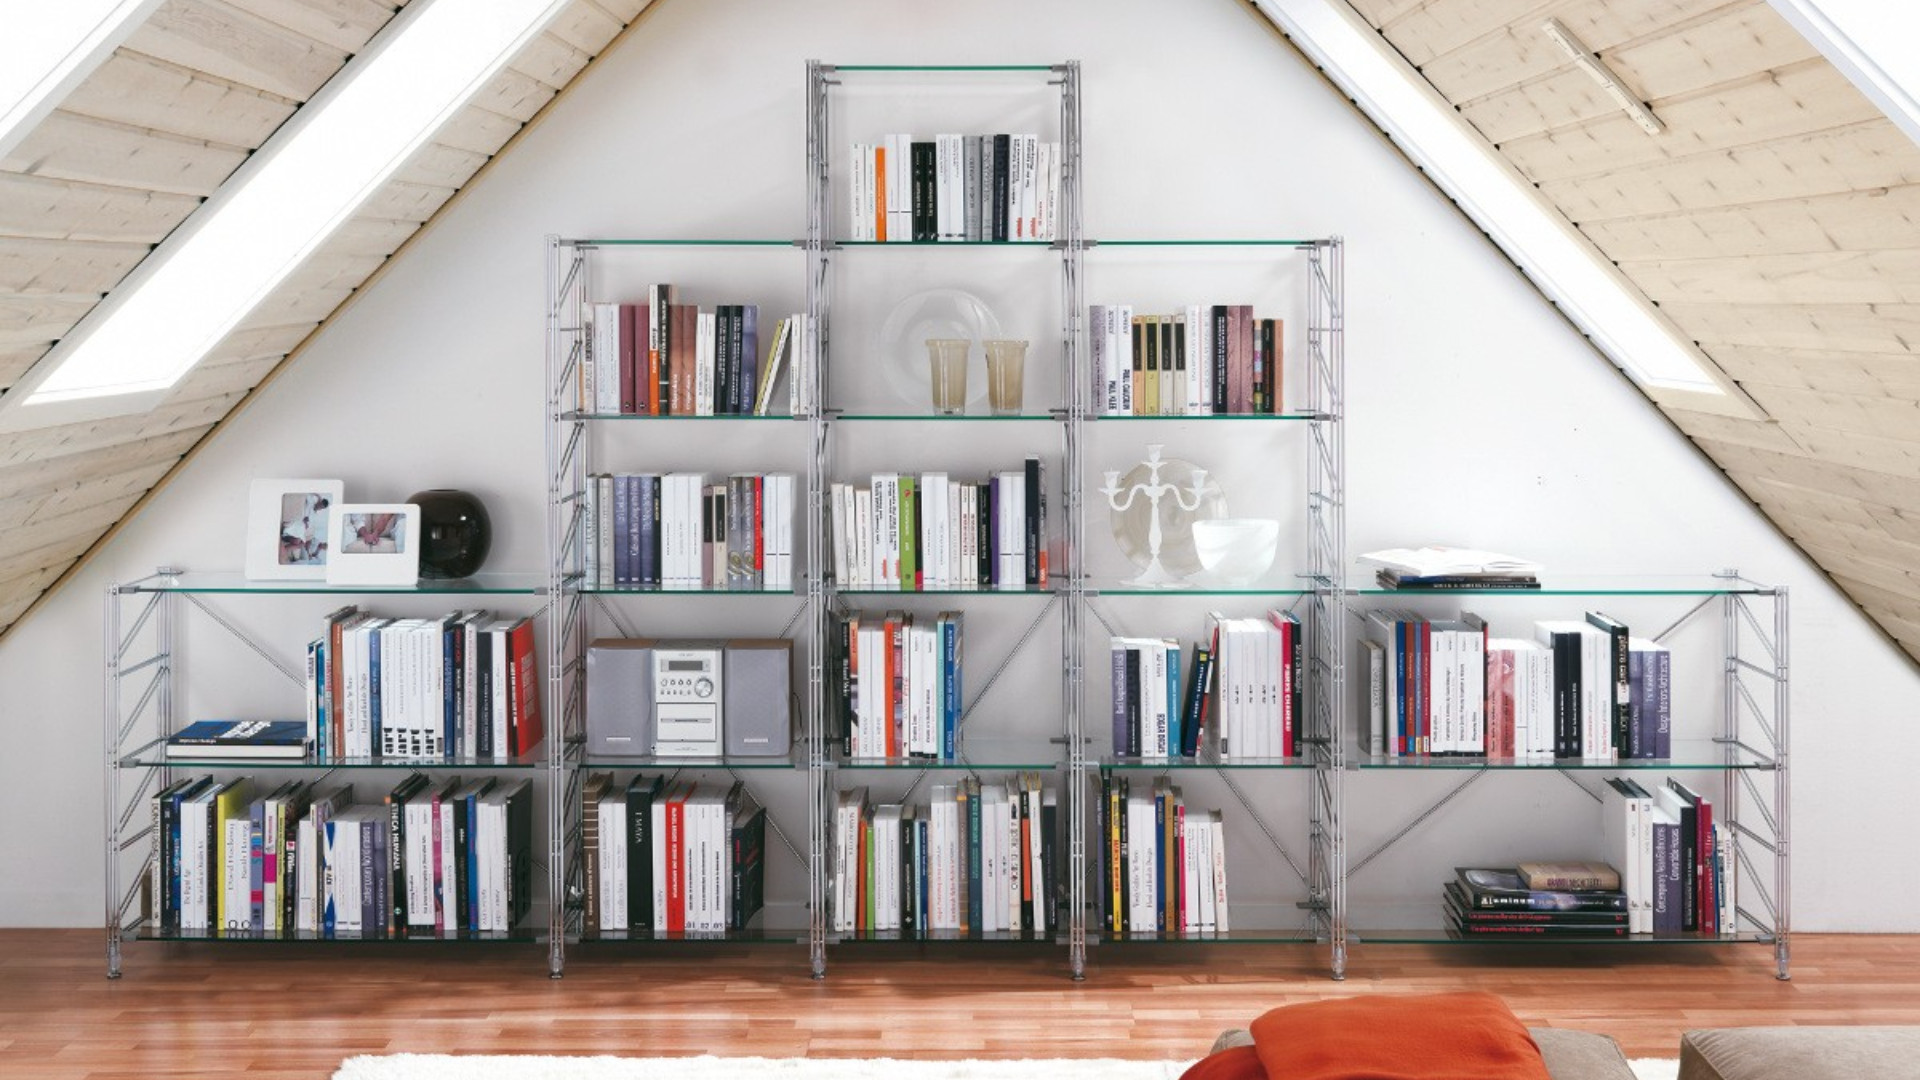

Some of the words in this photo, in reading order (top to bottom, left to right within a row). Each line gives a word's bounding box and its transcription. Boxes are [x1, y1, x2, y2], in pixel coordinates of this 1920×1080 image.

[1123, 369, 1131, 383] PAUL
[1108, 380, 1117, 395] PAUL
[1108, 396, 1117, 411] KLEE
[1481, 896, 1535, 905] Aluminum
